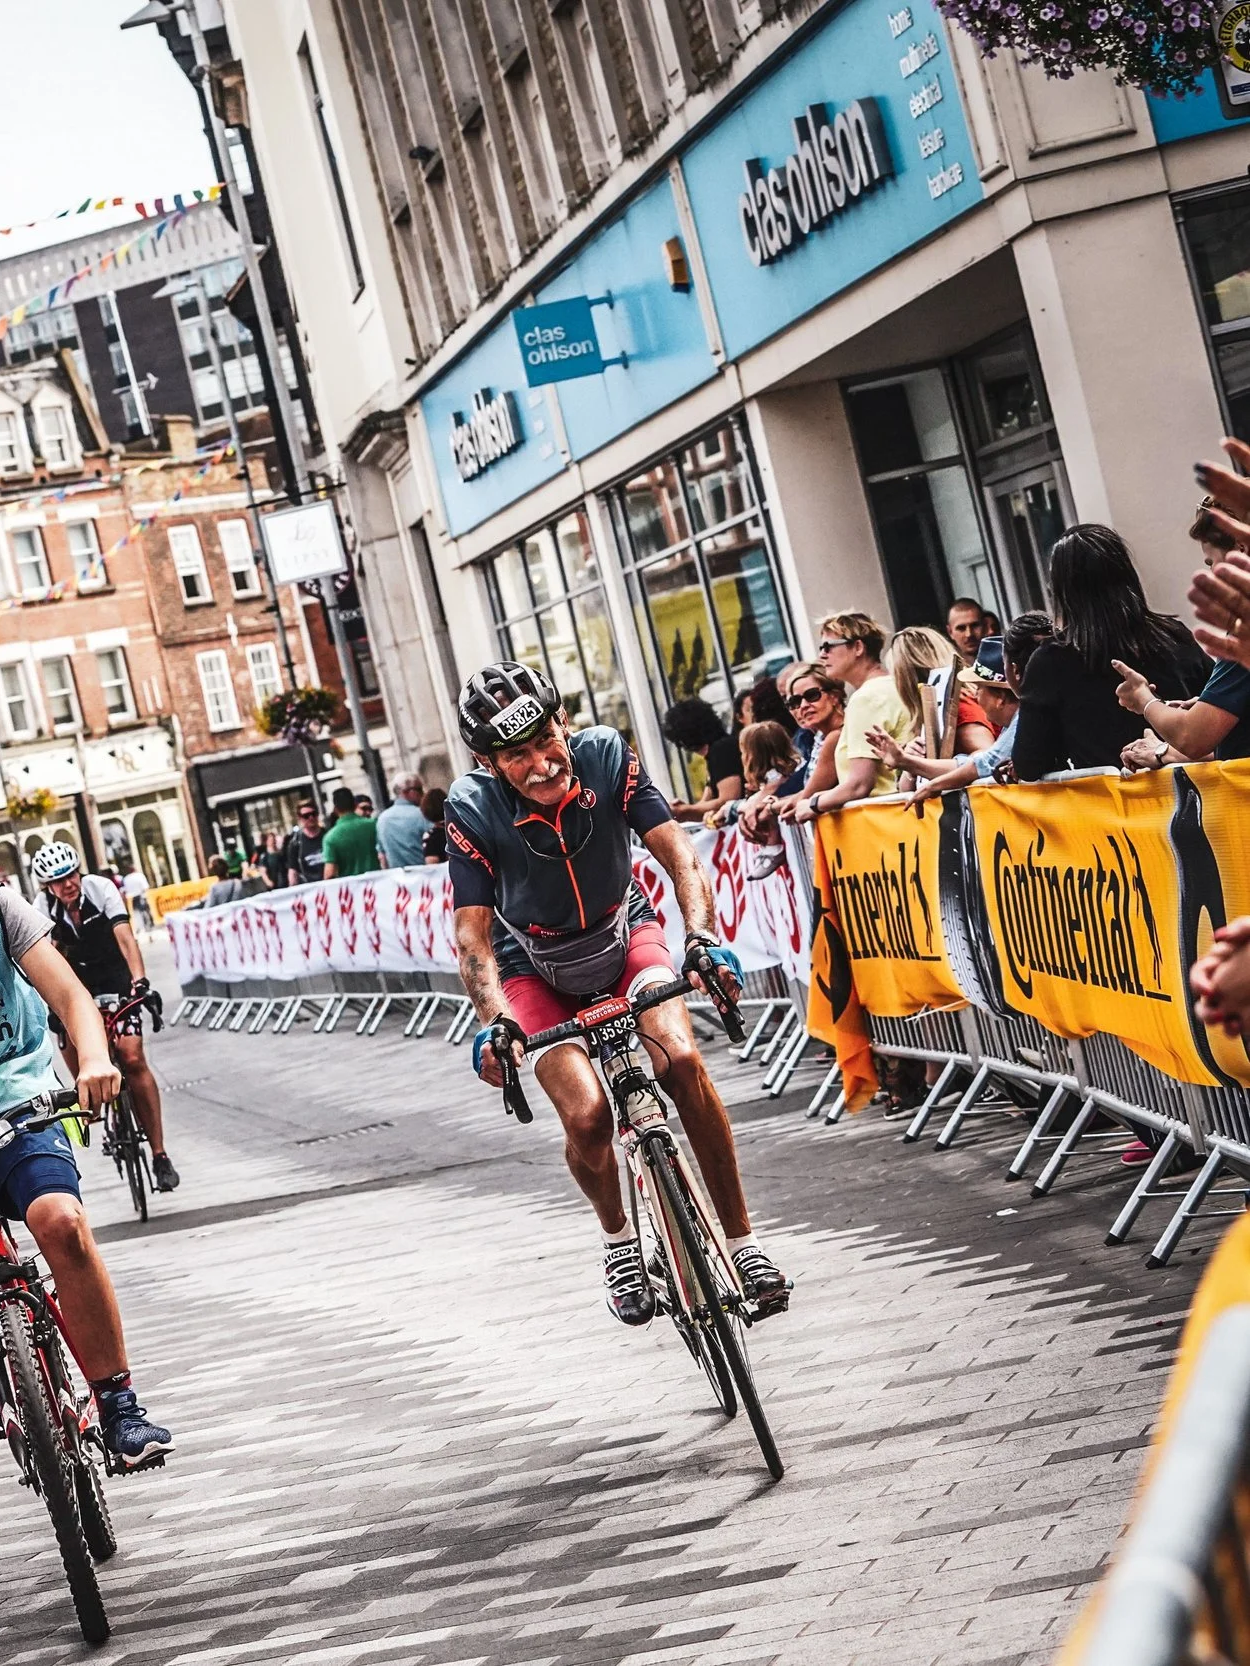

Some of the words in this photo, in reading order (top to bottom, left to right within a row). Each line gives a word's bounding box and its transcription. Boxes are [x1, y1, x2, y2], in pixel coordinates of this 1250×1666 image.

[1221, 5, 1250, 48] NEIGHBO
[738, 158, 791, 267] clas
[786, 99, 880, 234] ohlson
[524, 325, 566, 347] clas
[528, 340, 594, 365] ohlson
[502, 703, 537, 735] 35825
[994, 828, 1146, 1000] Continental
[591, 1031, 598, 1046] J
